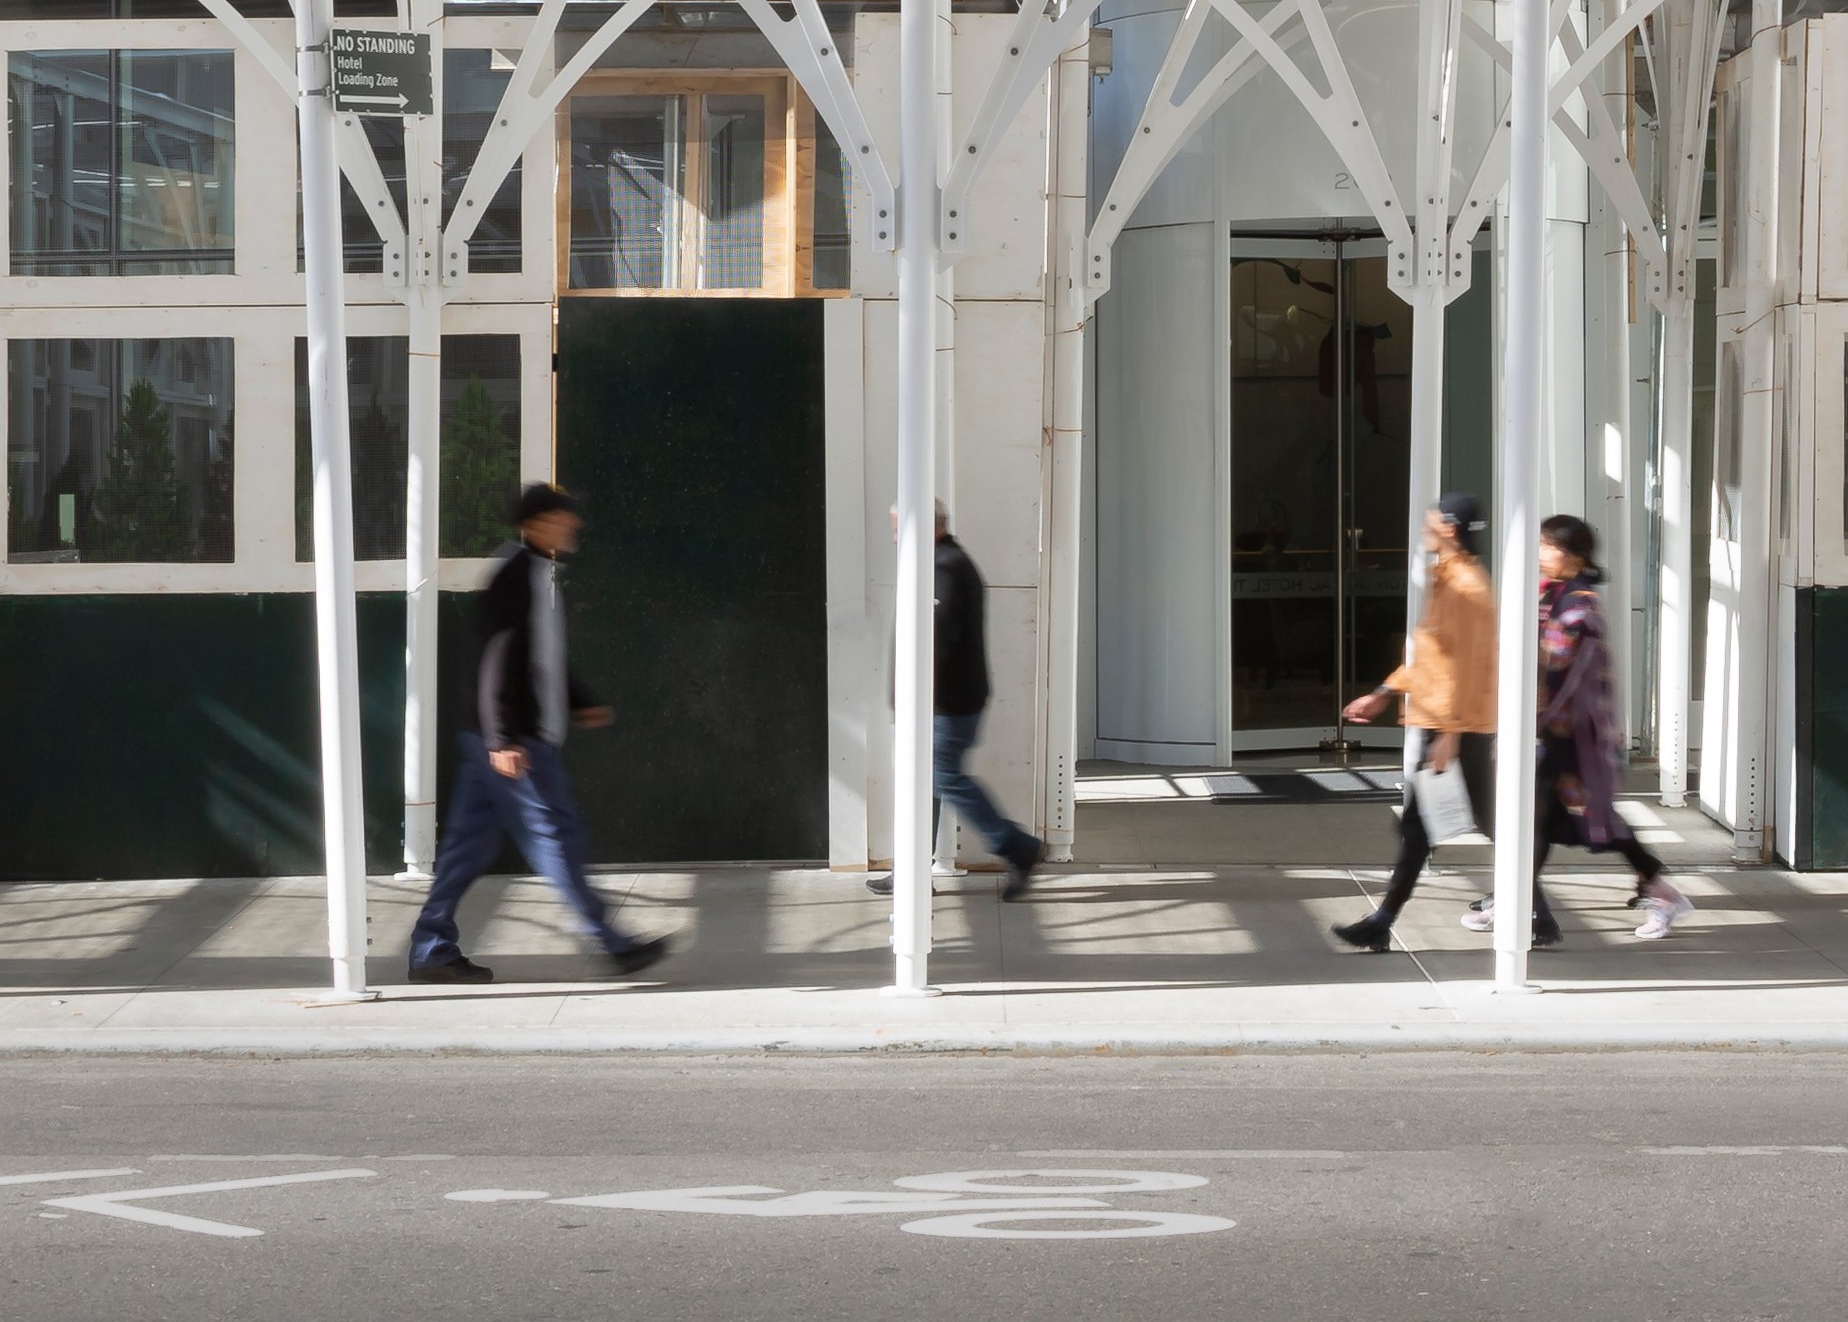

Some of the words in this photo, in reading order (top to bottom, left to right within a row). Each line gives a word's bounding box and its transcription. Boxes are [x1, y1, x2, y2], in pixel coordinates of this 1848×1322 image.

[336, 36, 354, 52] NO
[357, 37, 415, 54] STANDING
[337, 56, 363, 69] Hotel
[339, 72, 374, 88] Loading
[376, 74, 399, 87] Zone
